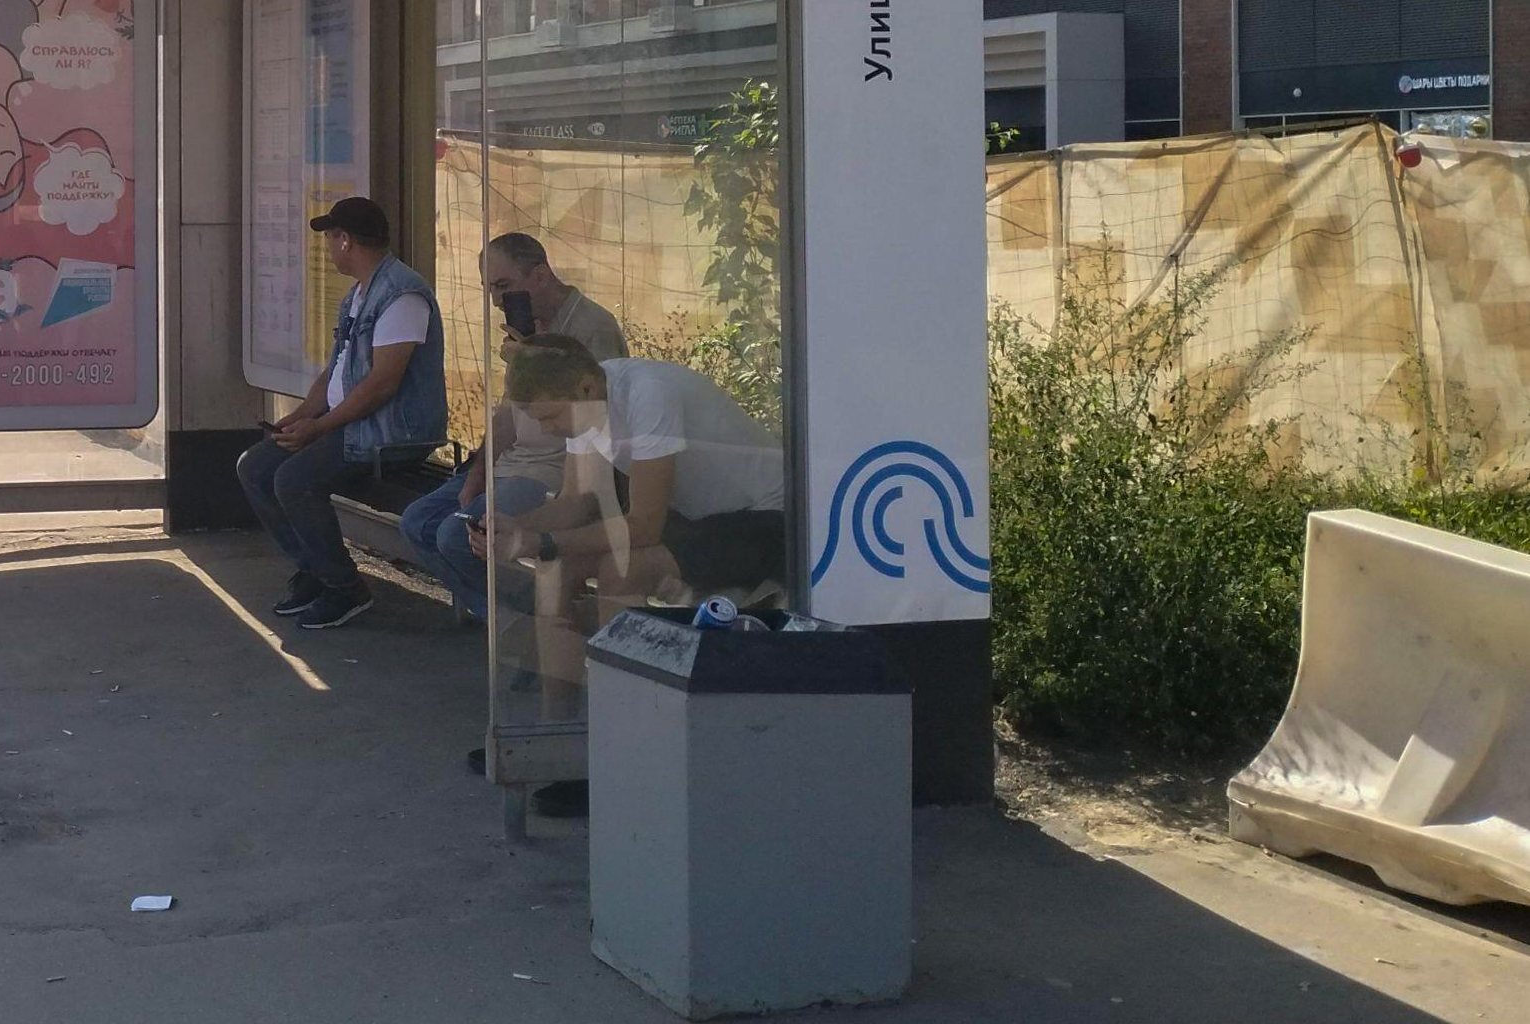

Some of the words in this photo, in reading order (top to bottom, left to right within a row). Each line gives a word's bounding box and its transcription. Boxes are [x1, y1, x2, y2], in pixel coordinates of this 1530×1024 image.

[32, 45, 115, 57] СПРАВЛЮСЬ
[55, 59, 72, 69] ЛИ
[71, 170, 91, 179] ГДЕ
